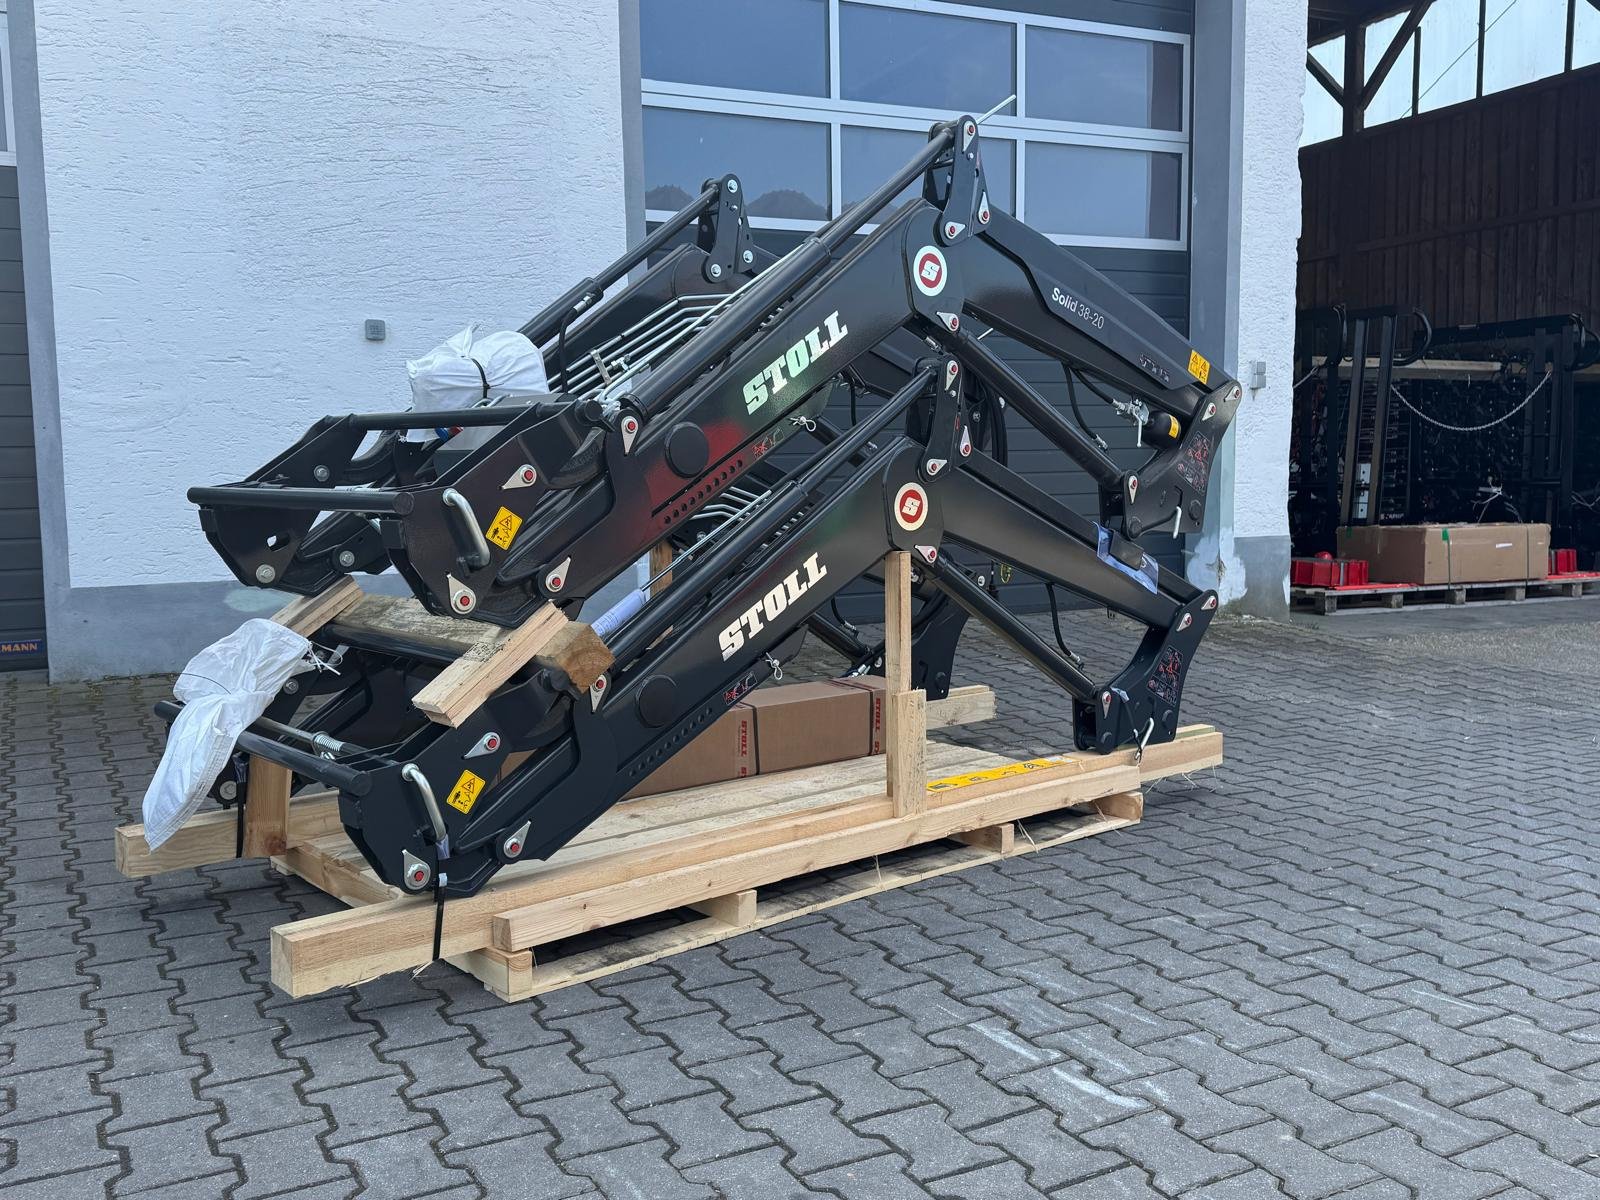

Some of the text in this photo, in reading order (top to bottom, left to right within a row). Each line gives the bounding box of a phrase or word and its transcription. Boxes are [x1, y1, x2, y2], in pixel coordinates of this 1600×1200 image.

[1052, 287, 1104, 329] Solid 38-20
[743, 311, 848, 415] STOLL
[719, 552, 828, 662] STOLL
